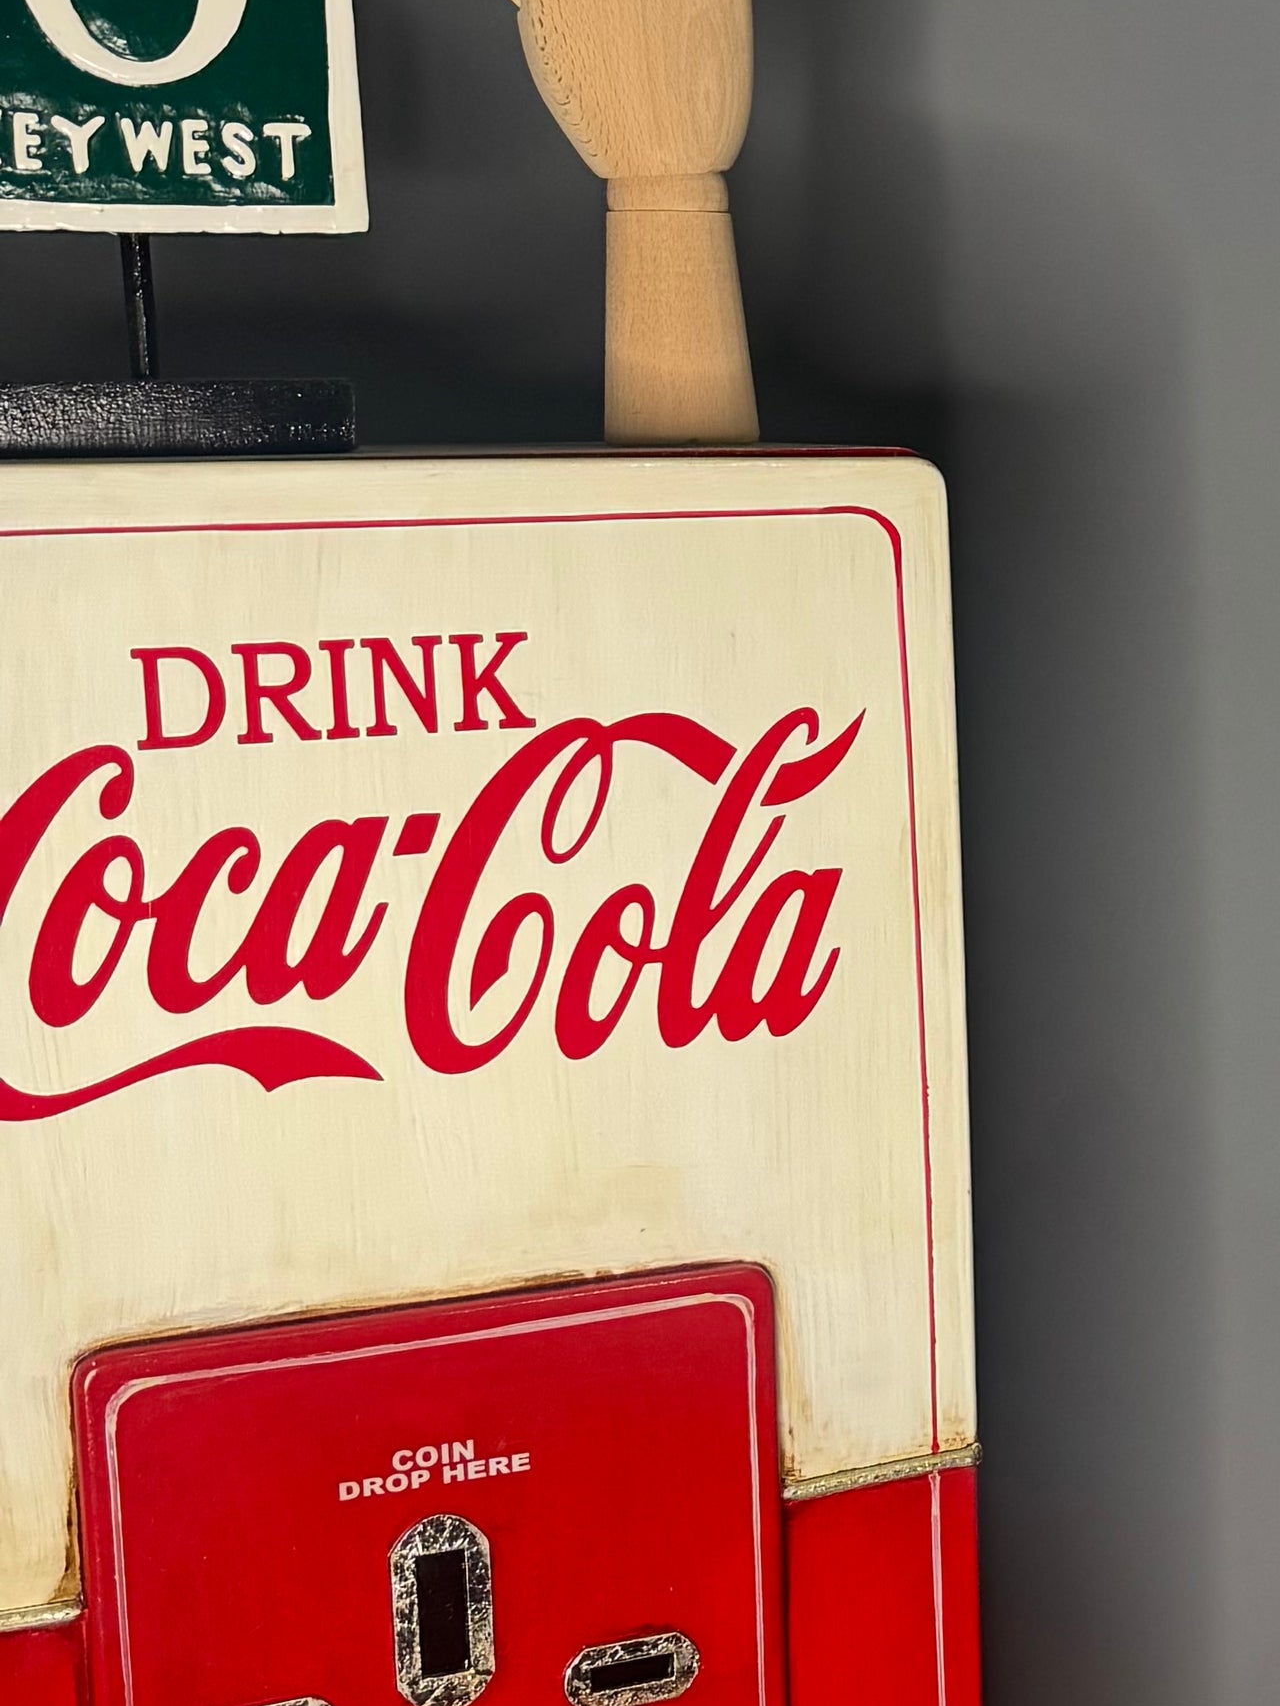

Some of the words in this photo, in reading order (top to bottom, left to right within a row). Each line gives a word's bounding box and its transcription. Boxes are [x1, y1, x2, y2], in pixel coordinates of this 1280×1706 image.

[0, 111, 105, 175] EY
[119, 117, 312, 181] WEST
[131, 631, 537, 751] DRINK
[338, 1469, 431, 1501] DROP
[442, 1452, 531, 1484] HERE
[391, 1439, 475, 1472] COIN
